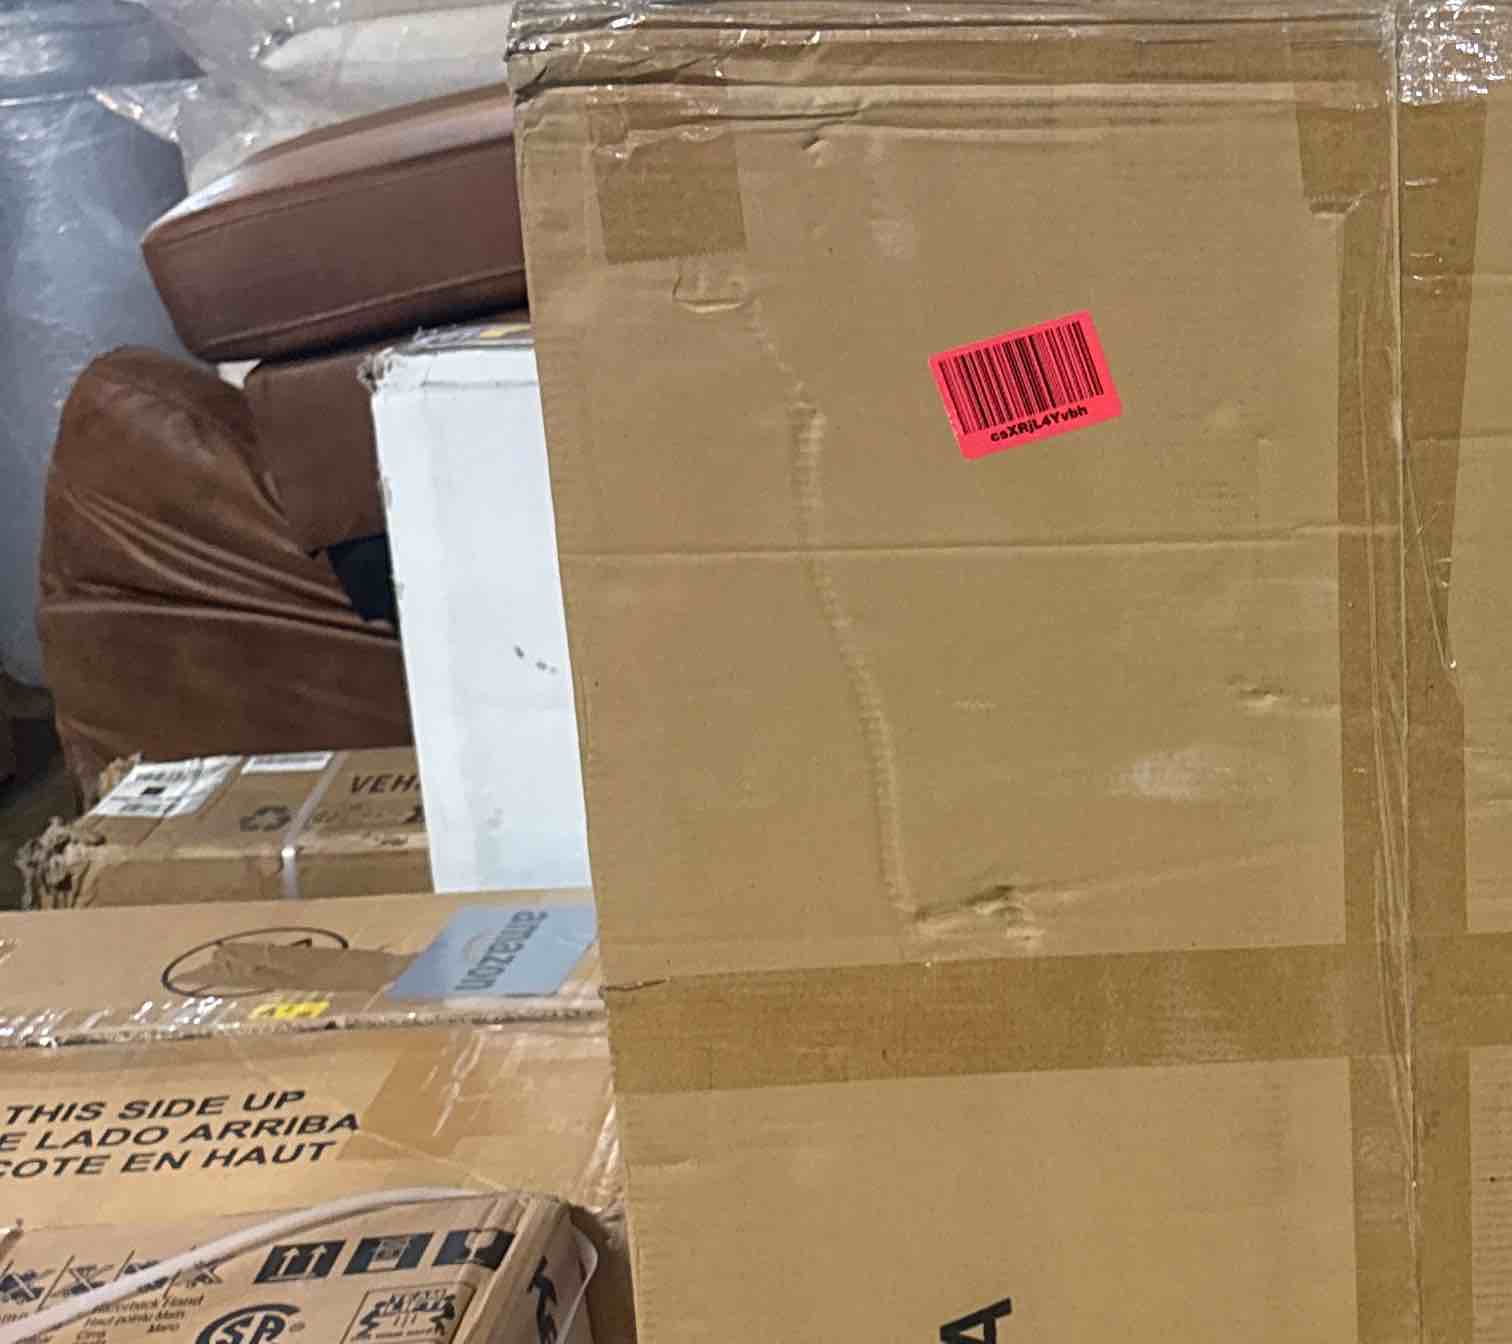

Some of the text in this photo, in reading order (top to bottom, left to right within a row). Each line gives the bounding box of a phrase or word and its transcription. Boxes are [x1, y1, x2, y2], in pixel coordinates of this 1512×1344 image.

[350, 772, 419, 794] VEH
[454, 909, 551, 992] amazon
[6, 1089, 307, 1126] THIS SIDE UP
[37, 1124, 168, 1151] LADO
[179, 1111, 362, 1144] ARRIBA
[120, 1149, 189, 1174] EN
[201, 1140, 338, 1169] HAUT
